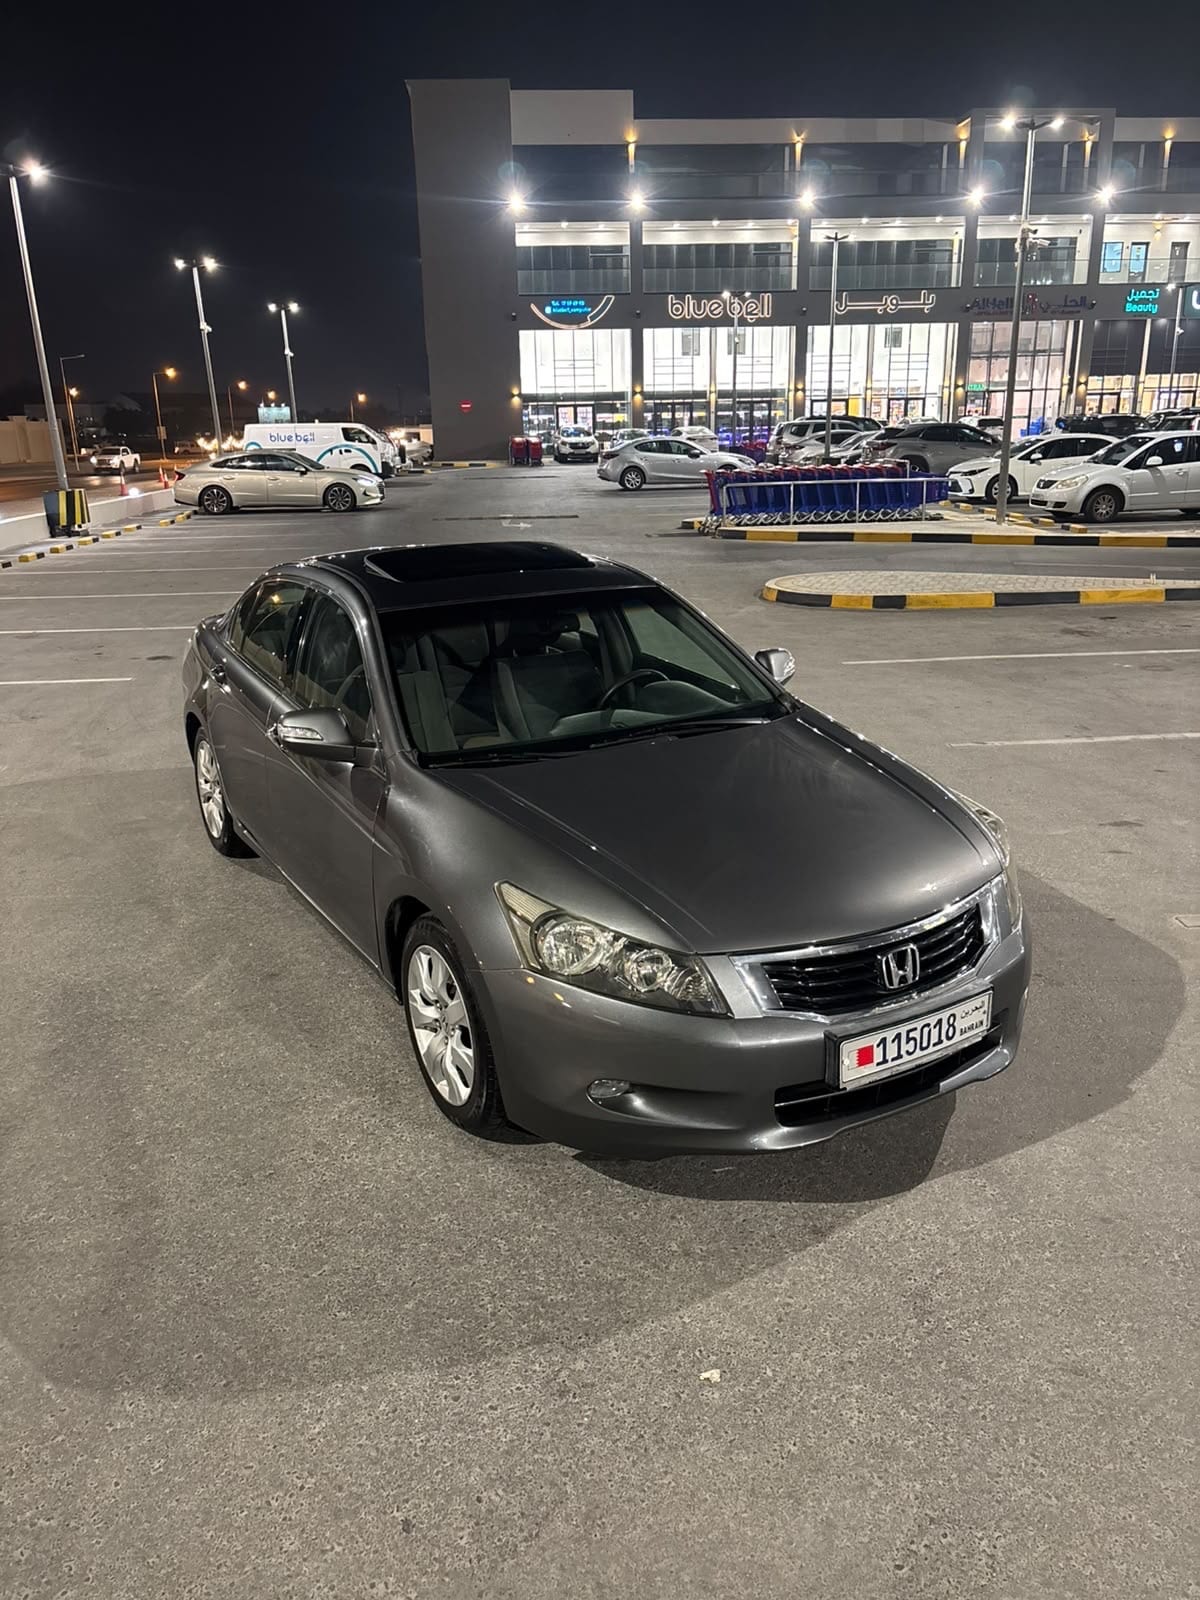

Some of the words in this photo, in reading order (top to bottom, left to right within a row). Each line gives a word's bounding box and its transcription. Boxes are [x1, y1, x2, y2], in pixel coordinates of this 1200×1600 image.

[1126, 288, 1160, 301] تجميل
[1125, 302, 1158, 314] Beauty
[959, 1020, 985, 1037] BAHRAIN
[875, 1013, 957, 1067] 115018
